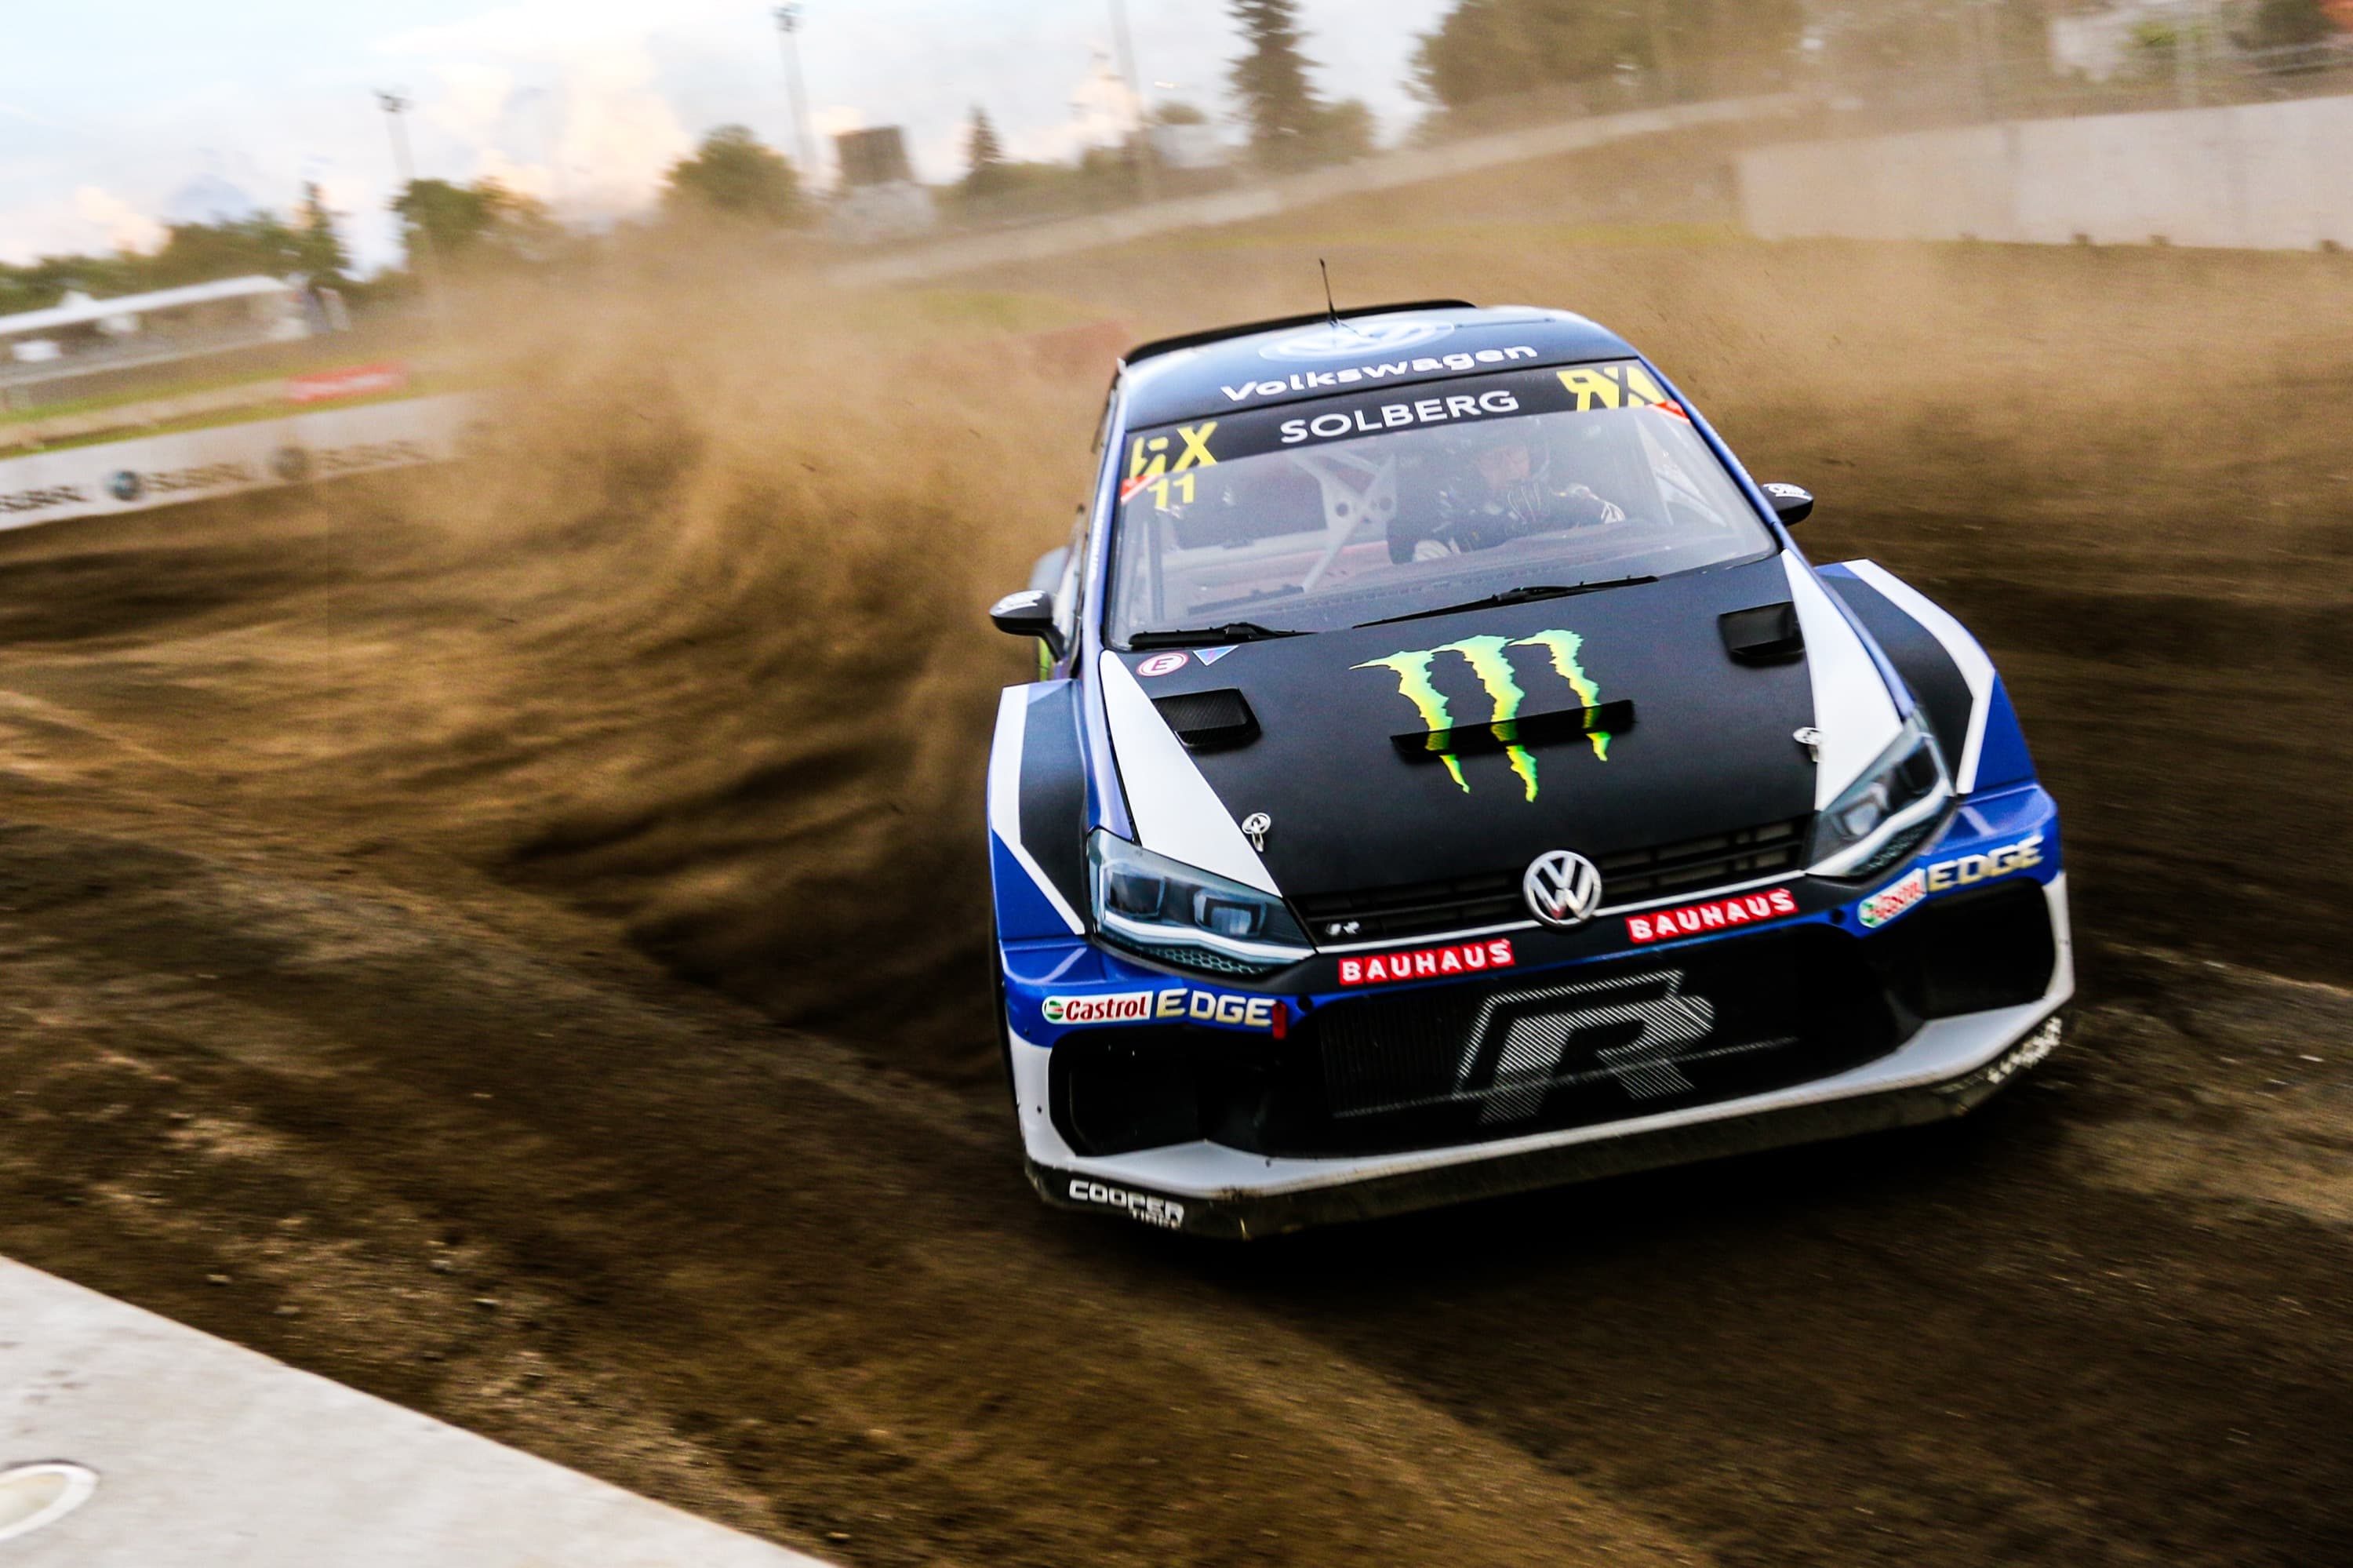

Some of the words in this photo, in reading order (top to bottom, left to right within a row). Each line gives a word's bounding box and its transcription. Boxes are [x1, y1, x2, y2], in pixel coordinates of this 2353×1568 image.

[1220, 345, 1538, 401] Volkswagen
[1280, 391, 1519, 443] SOLBERG
[1147, 472, 1195, 510] 11
[1927, 835, 2044, 892] EDGE
[1628, 889, 1795, 940] BAUHAUS
[1341, 939, 1511, 982] BAUHAUS
[1065, 995, 1147, 1021] Castrol
[1155, 988, 1275, 1028] EDGE
[1069, 1179, 1184, 1224] COOPER
